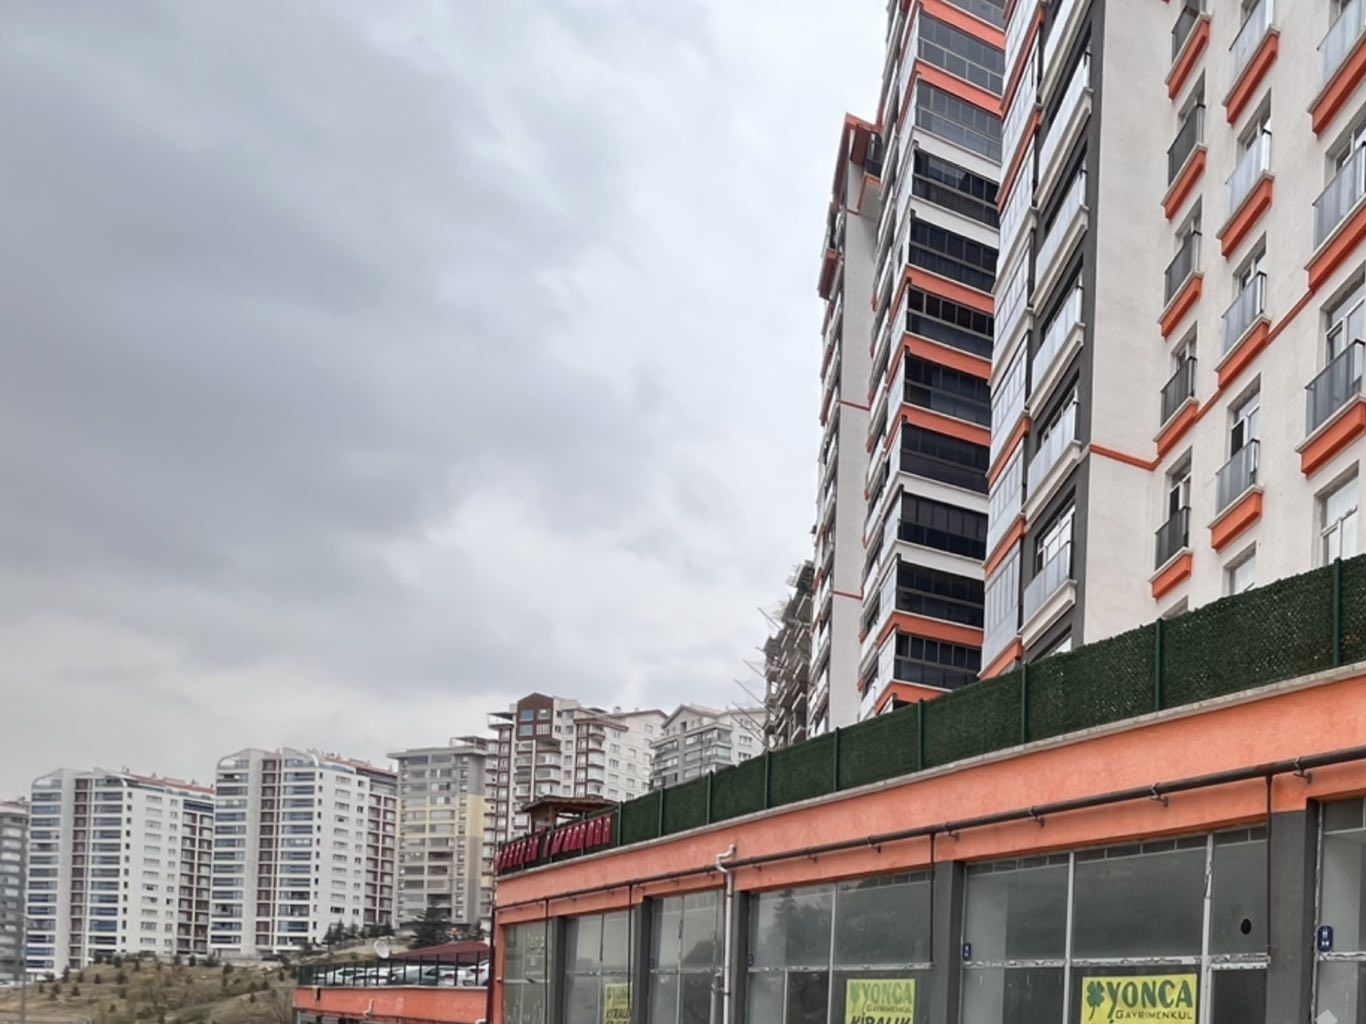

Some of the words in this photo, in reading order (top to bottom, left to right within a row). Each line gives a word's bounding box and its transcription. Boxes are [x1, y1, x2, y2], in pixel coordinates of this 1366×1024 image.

[862, 982, 912, 1012] YONCA
[1106, 980, 1193, 1019] YONCA
[1115, 1009, 1193, 1020] GAYRIMENKUL
